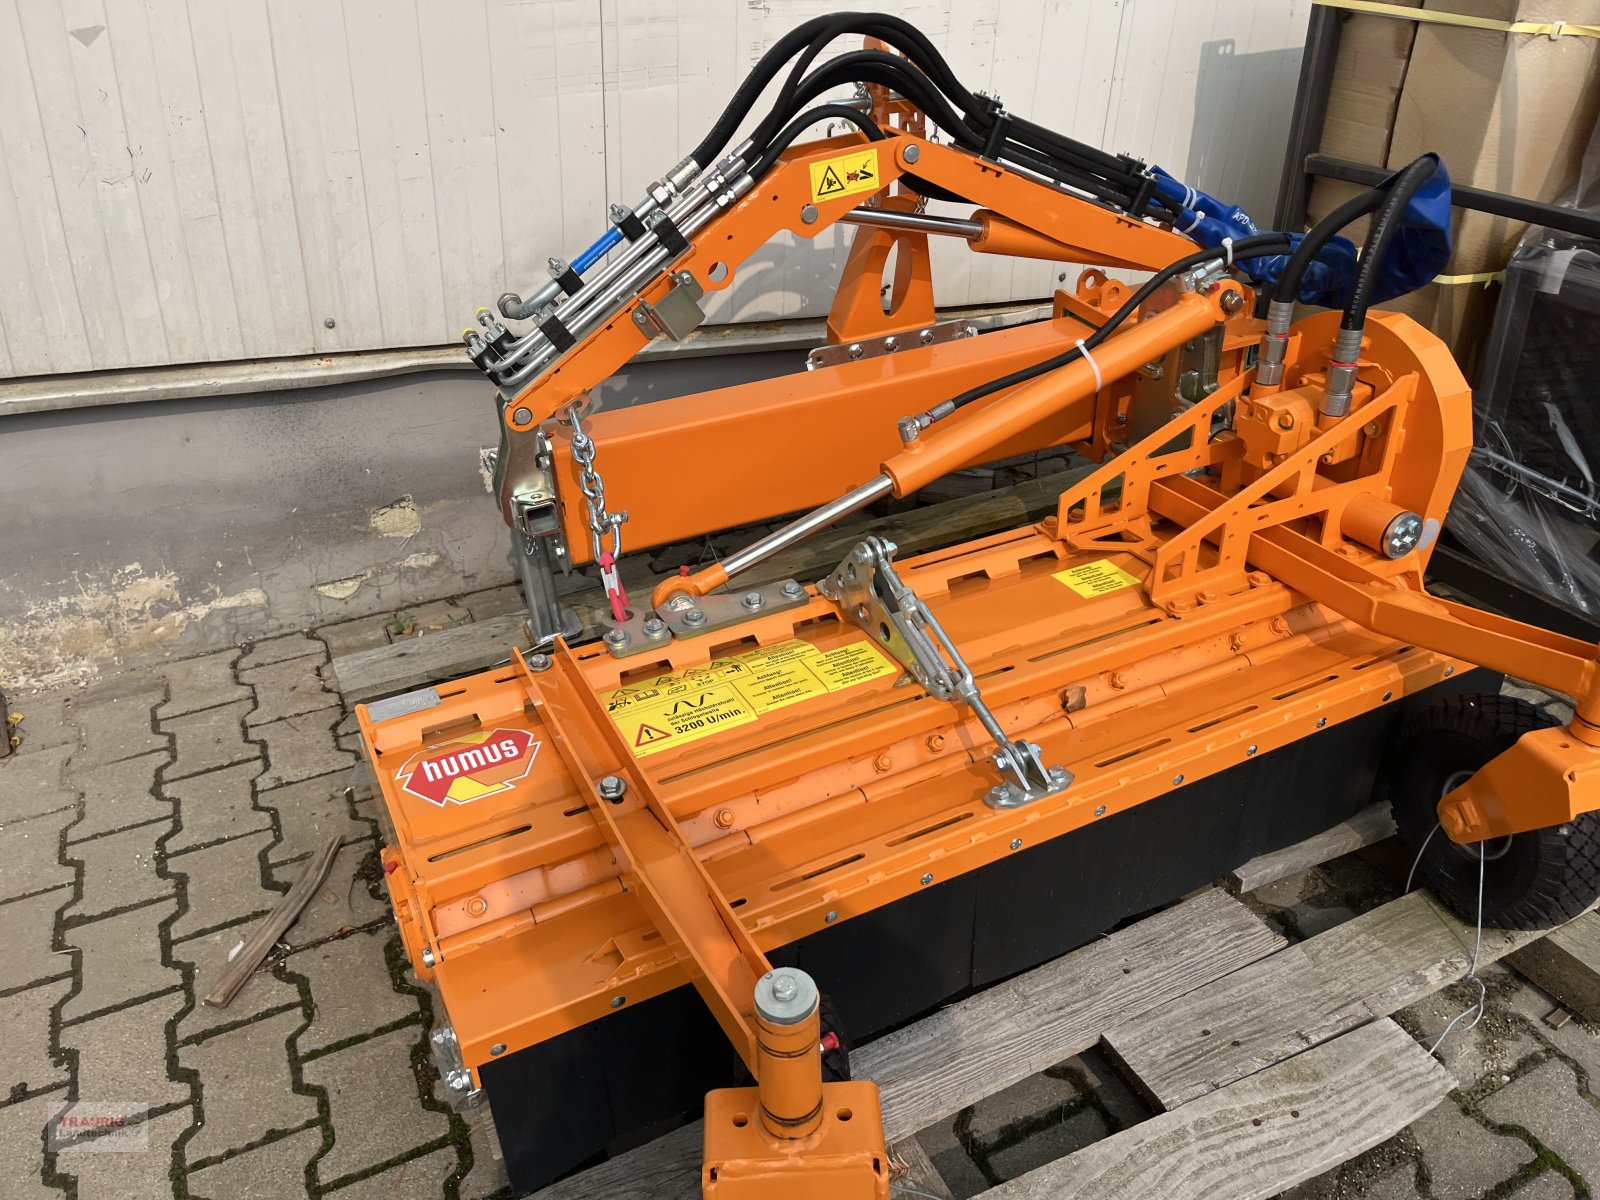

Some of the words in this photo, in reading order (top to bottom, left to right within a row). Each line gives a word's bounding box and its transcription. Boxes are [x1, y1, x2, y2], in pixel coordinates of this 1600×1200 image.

[767, 650, 794, 660] Attention!
[825, 648, 849, 658] Achtung!
[833, 657, 860, 667] Attention!
[757, 670, 782, 680] Achtung!
[842, 666, 869, 677] Attention!
[764, 679, 792, 690] Attention!
[772, 688, 801, 700] Attention!
[675, 719, 704, 734] 3200
[706, 708, 746, 723] U/min.
[421, 739, 520, 782] humus
